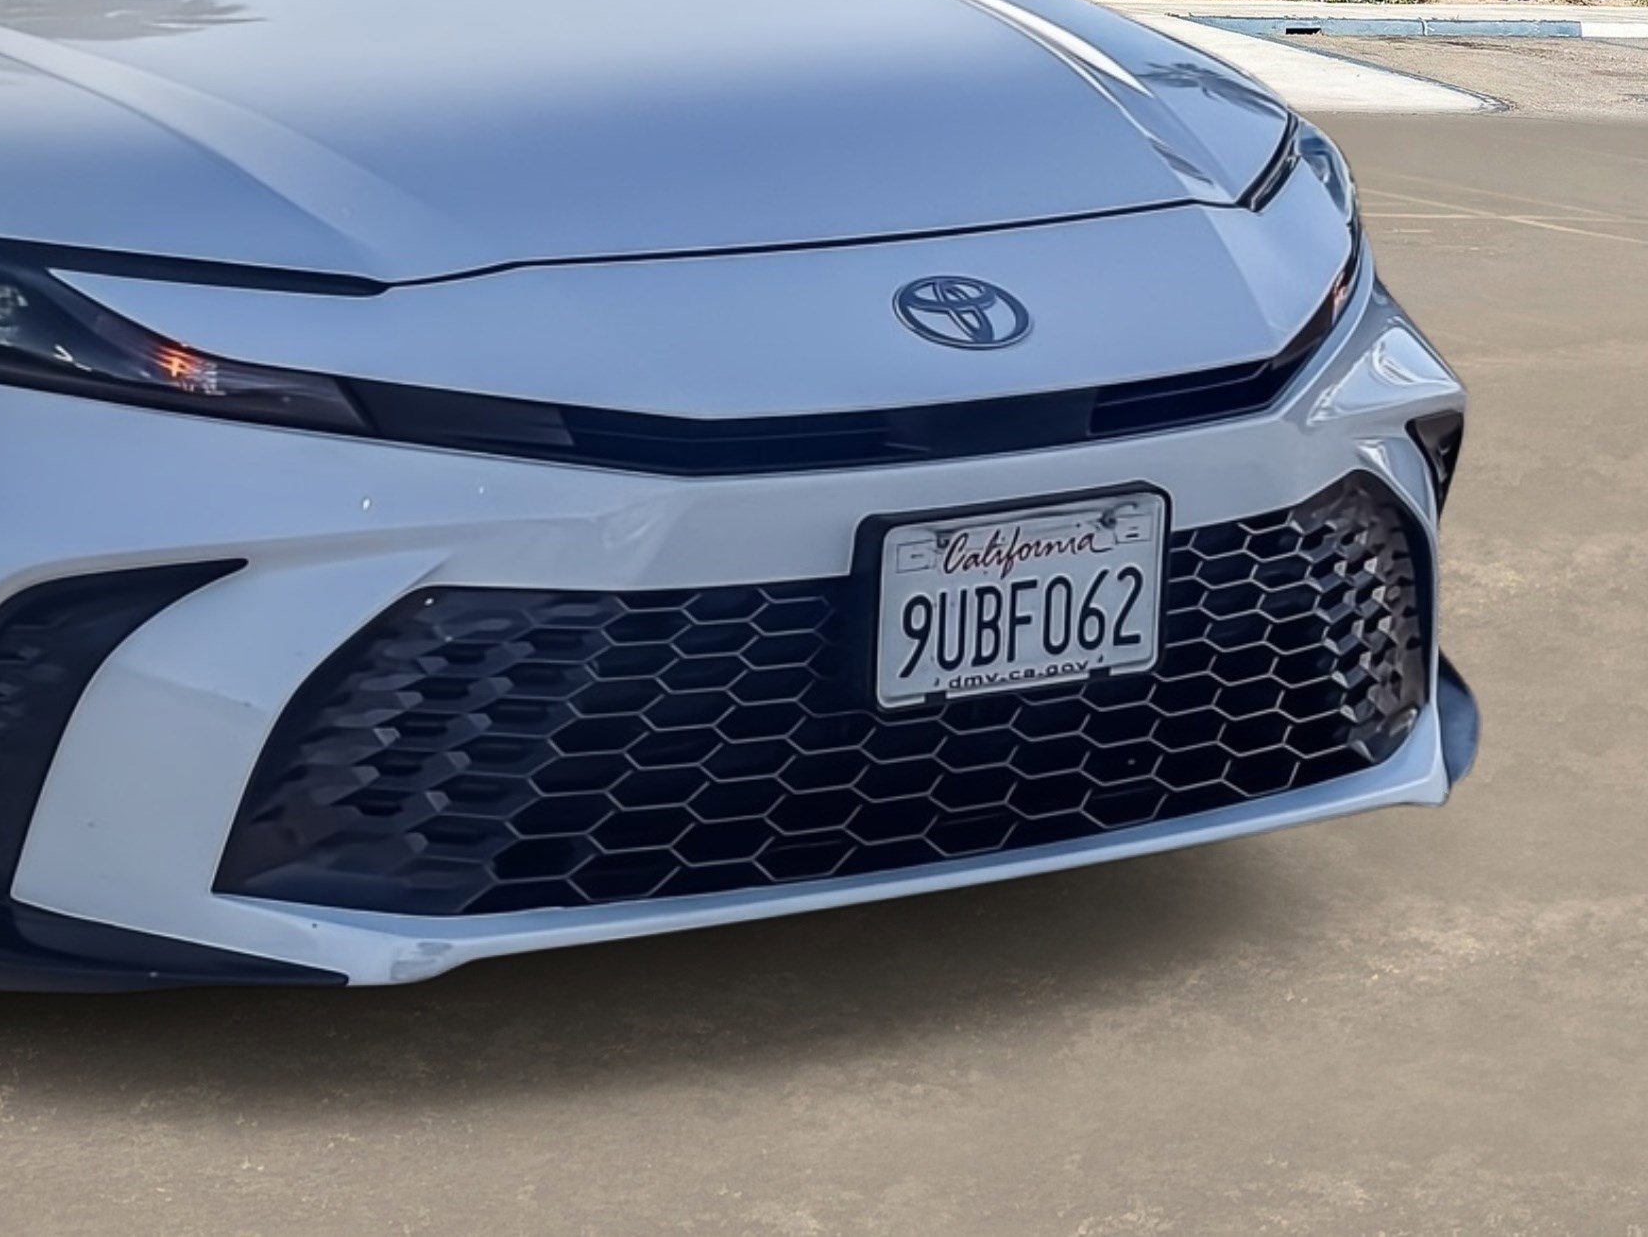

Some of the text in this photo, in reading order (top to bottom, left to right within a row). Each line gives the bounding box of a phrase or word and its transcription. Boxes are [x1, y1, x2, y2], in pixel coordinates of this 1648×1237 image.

[943, 526, 1114, 579] California
[899, 565, 1144, 679] 9UBF062
[948, 660, 1089, 690] dmv.ca.gov
